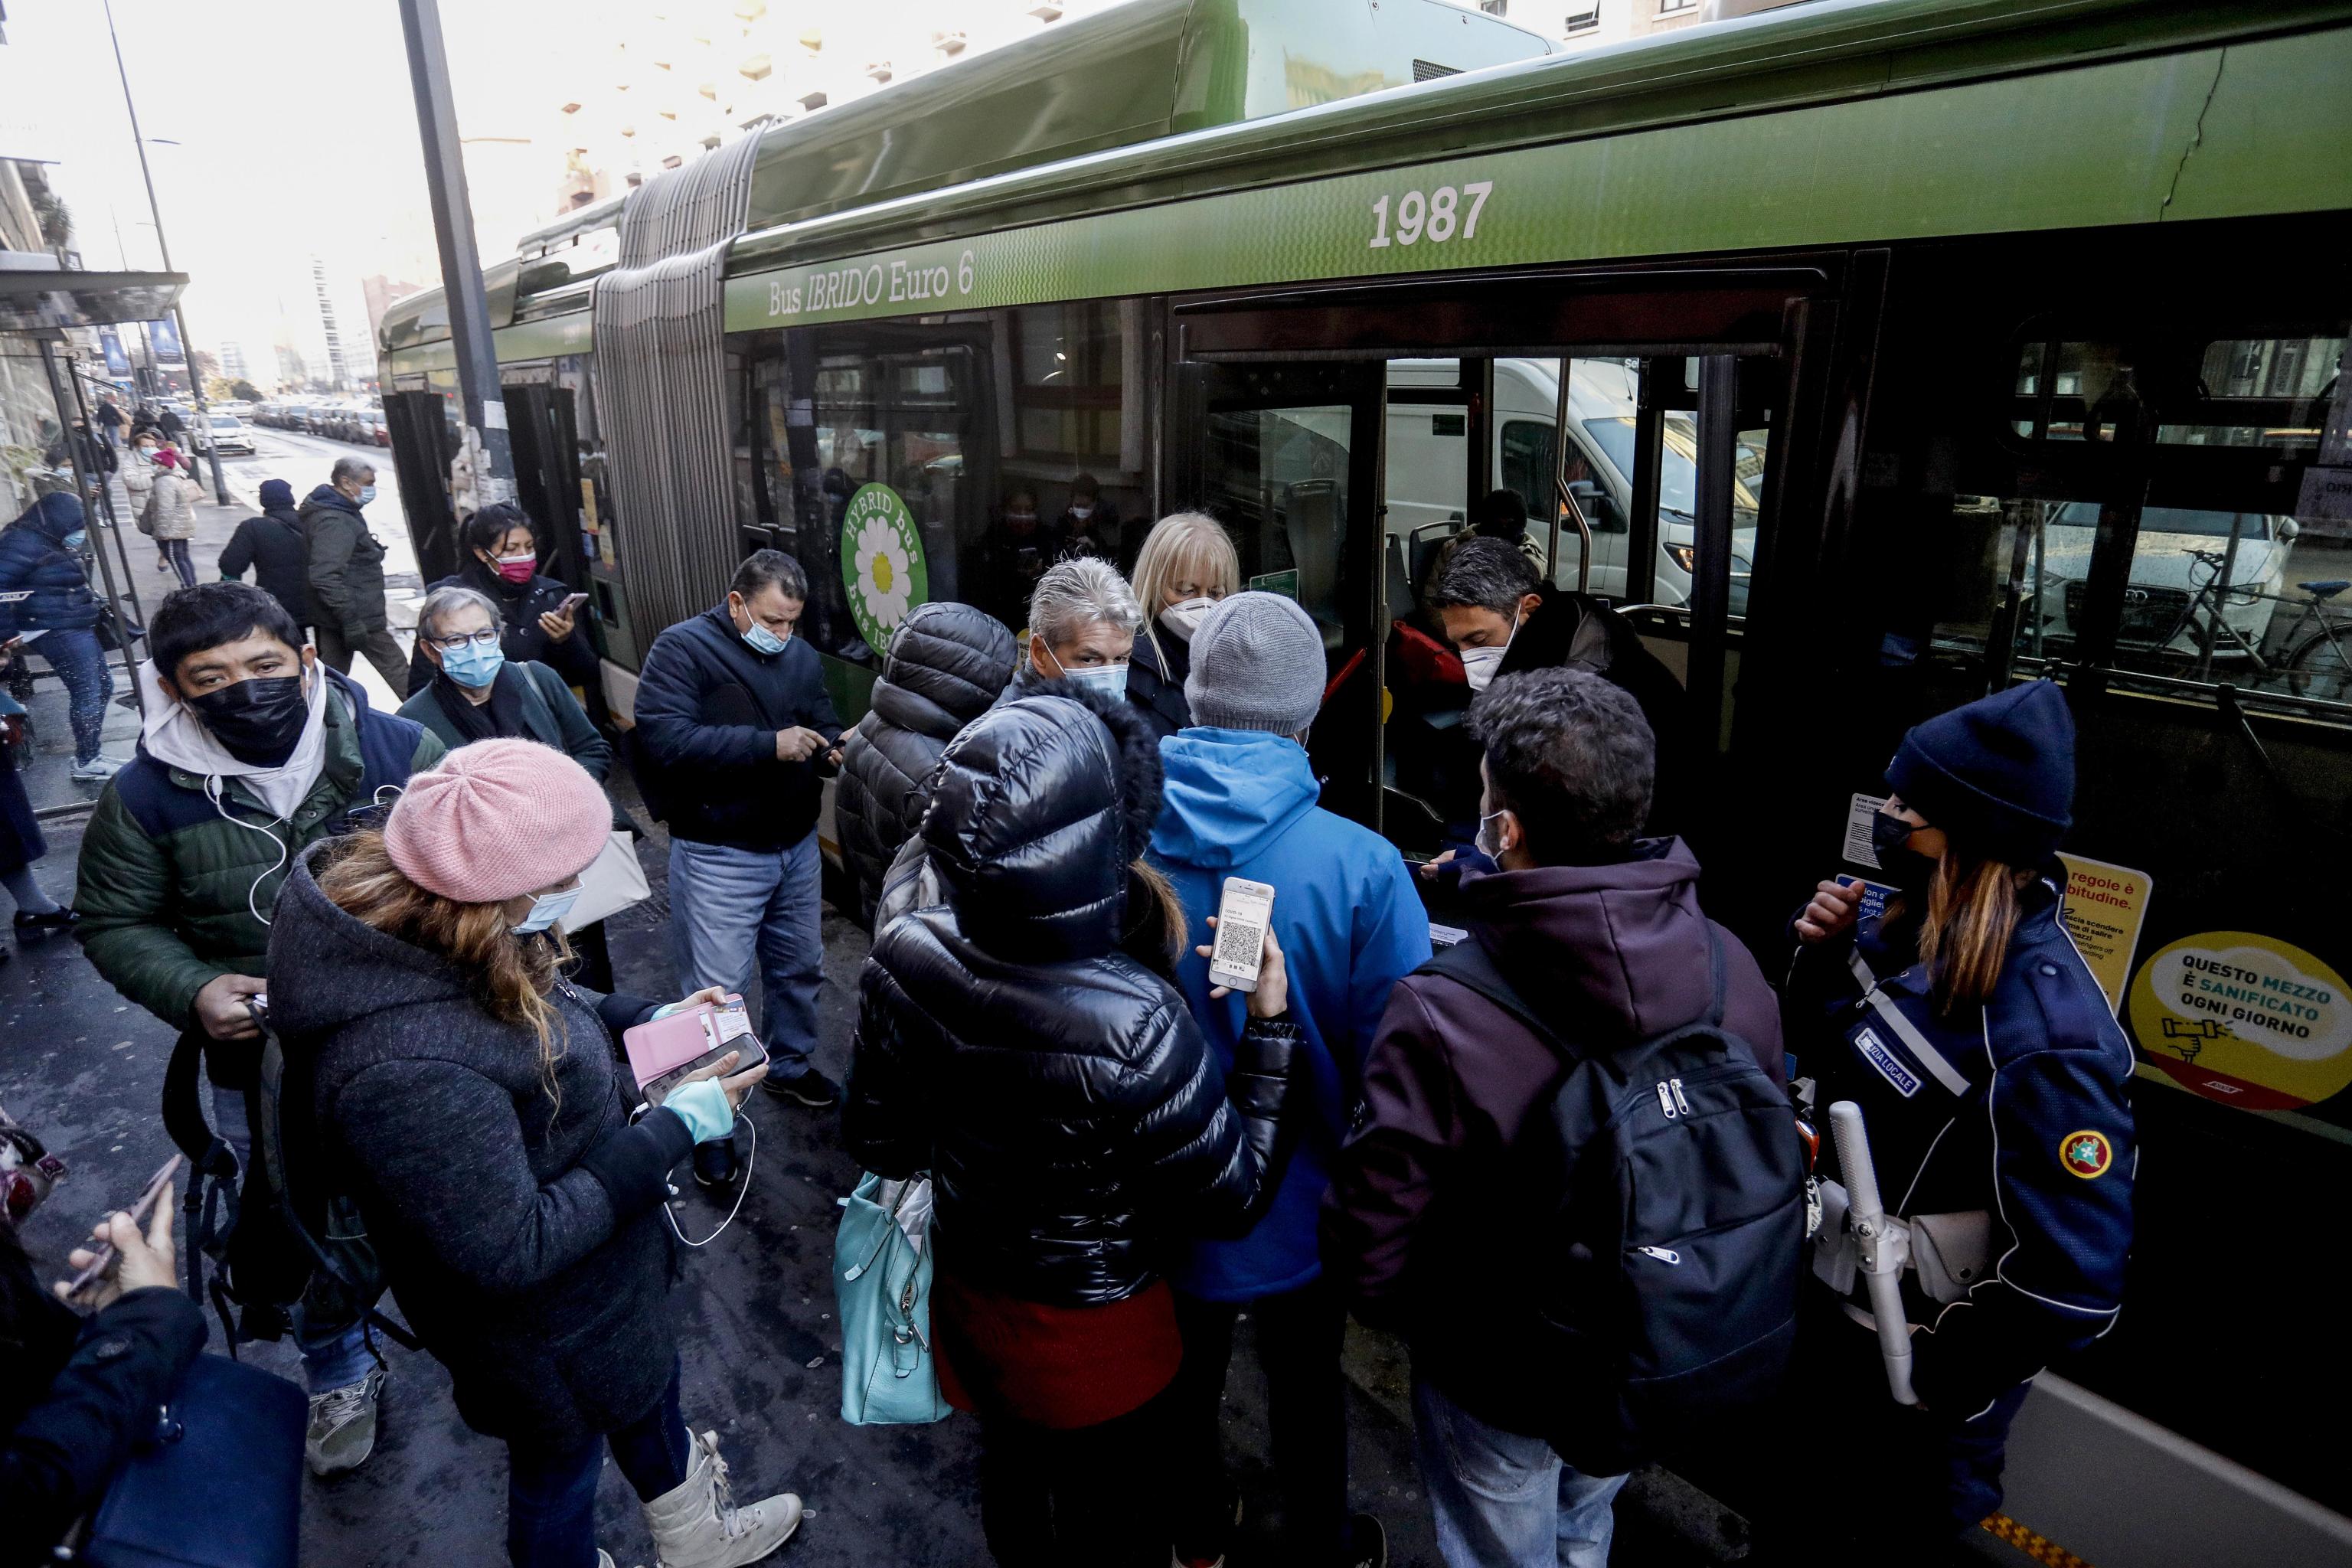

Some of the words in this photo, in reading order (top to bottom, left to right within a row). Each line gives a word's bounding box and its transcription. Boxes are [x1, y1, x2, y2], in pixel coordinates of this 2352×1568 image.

[1370, 181, 1493, 248] 1987
[769, 282, 801, 316] Bus
[805, 264, 883, 312] IBRIDO
[888, 260, 949, 302] Euro
[959, 250, 975, 294] 6
[845, 491, 892, 541] HYBRID
[896, 509, 918, 564] bus
[848, 582, 870, 632] bus
[2066, 884, 2132, 910] bitudine.
[2072, 871, 2120, 891] regole
[2125, 883, 2135, 895] è
[2082, 925, 2089, 933] di
[2090, 928, 2113, 939] salire
[2086, 920, 2124, 935] scendere
[2104, 947, 2115, 956] off
[2183, 956, 2258, 985] QUESTO
[2262, 975, 2331, 1004] MEZZO
[2183, 971, 2196, 988] È
[2199, 978, 2319, 1021] SANIFICATO
[2180, 993, 2229, 1016] OGNI
[2233, 1008, 2310, 1039] GIORNO
[1881, 1058, 1913, 1090] LOCALE
